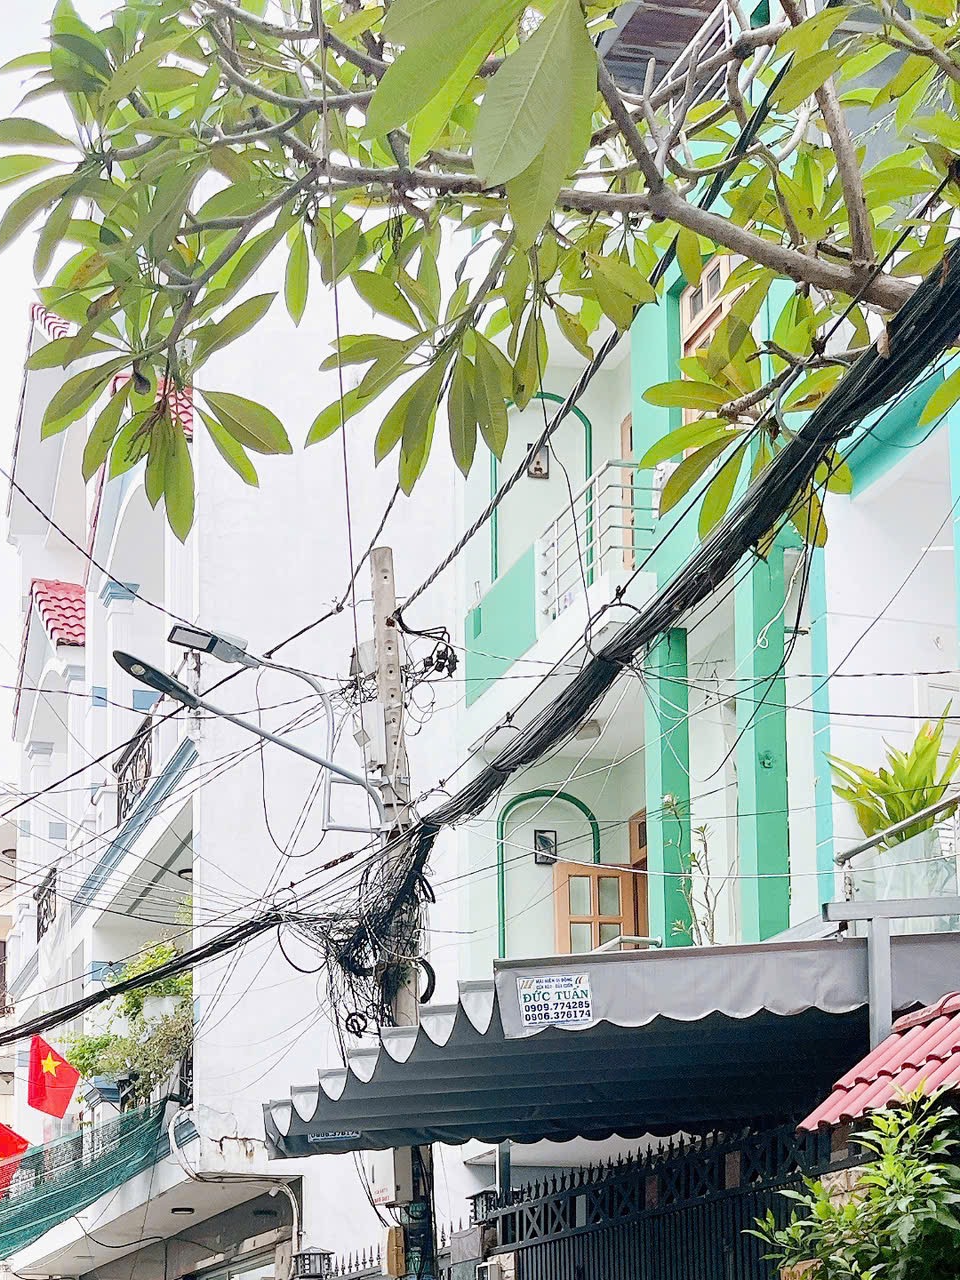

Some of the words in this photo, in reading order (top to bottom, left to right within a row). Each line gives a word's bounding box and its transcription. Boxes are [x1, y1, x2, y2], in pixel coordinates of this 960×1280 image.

[523, 990, 551, 1003] ĐỨC
[524, 1000, 590, 1013] 0909.774285
[525, 1009, 591, 1022] 0906.376174
